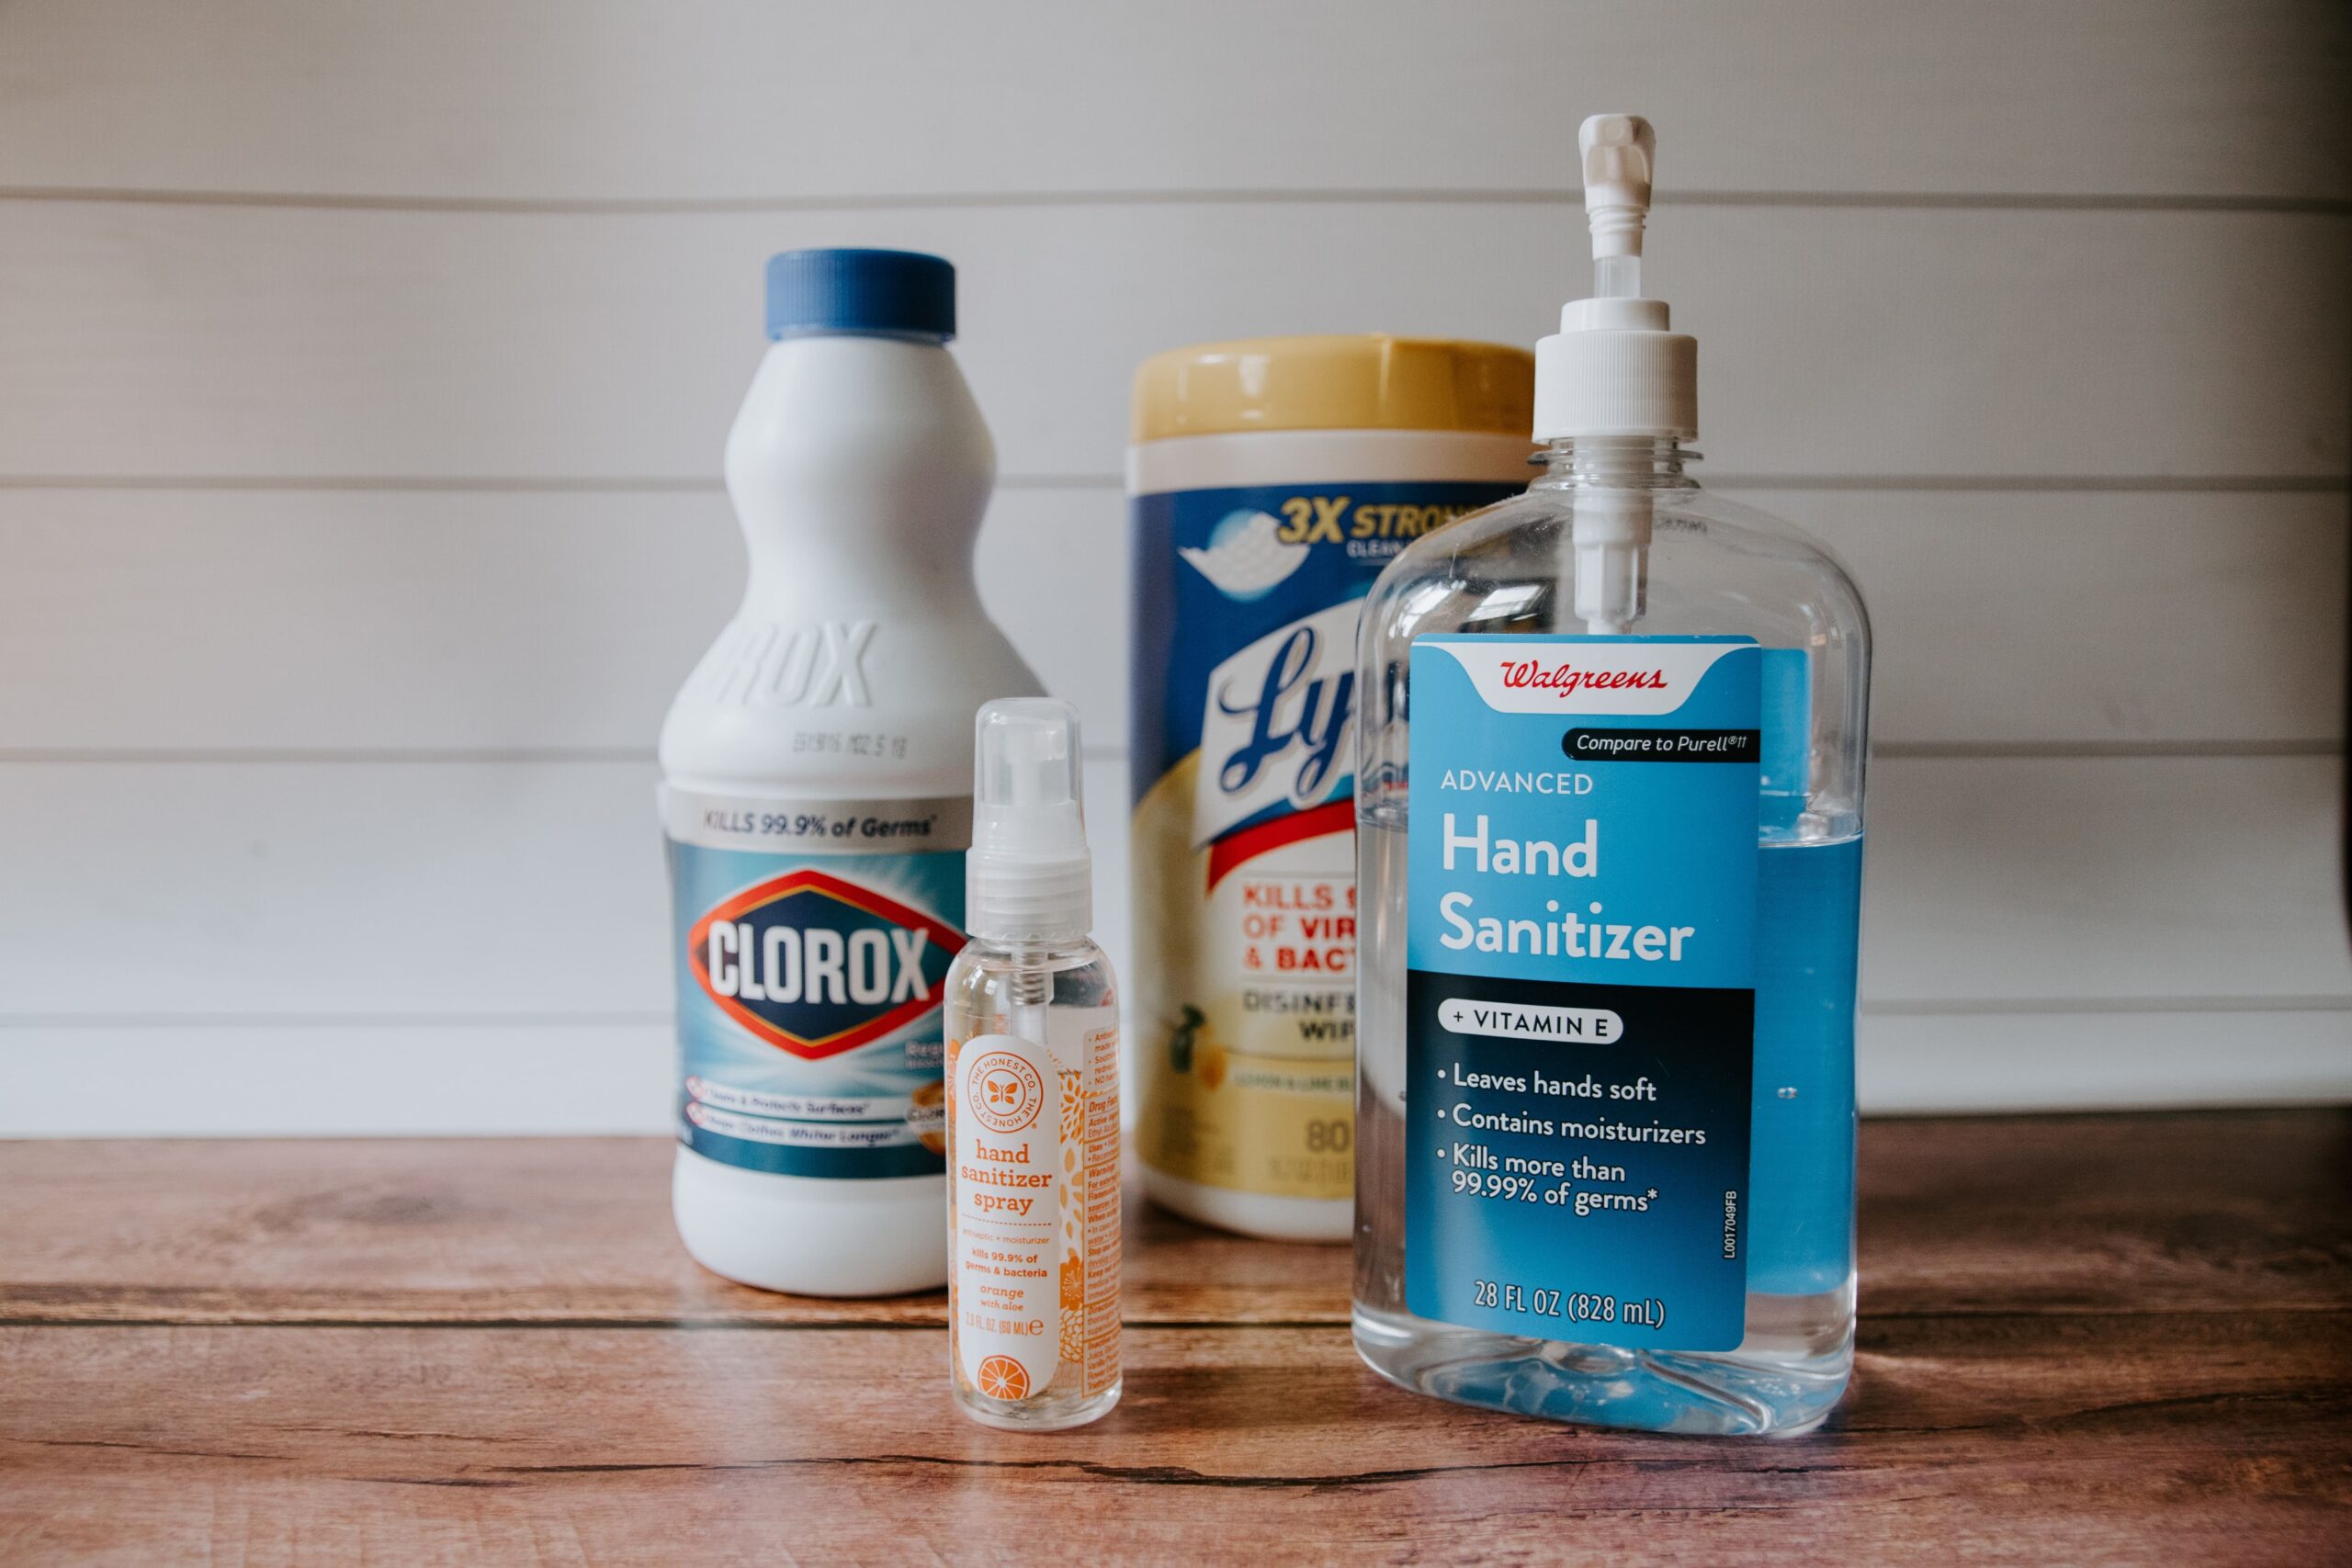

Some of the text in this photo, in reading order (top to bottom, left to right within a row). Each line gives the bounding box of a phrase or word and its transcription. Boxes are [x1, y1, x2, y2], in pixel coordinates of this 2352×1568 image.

[1278, 496, 1351, 544] 3X
[1500, 660, 1668, 698] Walgreens
[1577, 734, 1652, 755] Compare
[1656, 738, 1673, 751] to
[1441, 769, 1593, 795] ADVANCED
[704, 808, 757, 833] KILLS
[761, 814, 826, 838] 99.9%
[831, 817, 855, 838] of
[1443, 813, 1598, 877] Hand
[1244, 885, 1334, 909] KILLS
[1244, 914, 1283, 939] OF
[1440, 891, 1695, 961] Sanitizer
[708, 919, 932, 1004] CLOROX
[1245, 945, 1262, 969] &
[1474, 1010, 1582, 1036] VITAMIN
[1596, 1019, 1608, 1037] E
[972, 1066, 985, 1085] THE
[984, 1057, 1026, 1074] HONEST
[1453, 1062, 1657, 1101] Leaves hands soft
[1021, 1097, 1037, 1119] THE
[1089, 1100, 1106, 1112] Drug
[980, 1111, 1023, 1128] HONEST
[1453, 1103, 1706, 1145] Contains moisturizers
[1306, 1119, 1351, 1153] 80
[976, 1139, 1030, 1164] hand
[1453, 1143, 1626, 1182] Kills more than
[961, 1166, 1053, 1188] sanitizer
[1452, 1171, 1538, 1202] 99.99%
[1544, 1182, 1571, 1205] of
[974, 1193, 1034, 1216] spray
[1724, 1190, 1736, 1258] L0017049FB
[1002, 1235, 1050, 1245] moisturizer
[971, 1247, 1038, 1263] kills 99.9% of
[966, 1260, 1048, 1278] germs & bacteria
[979, 1284, 1024, 1300] orange
[980, 1299, 1024, 1311] with aloe
[1474, 1280, 1665, 1328] 28 FL OZ (828 mL)
